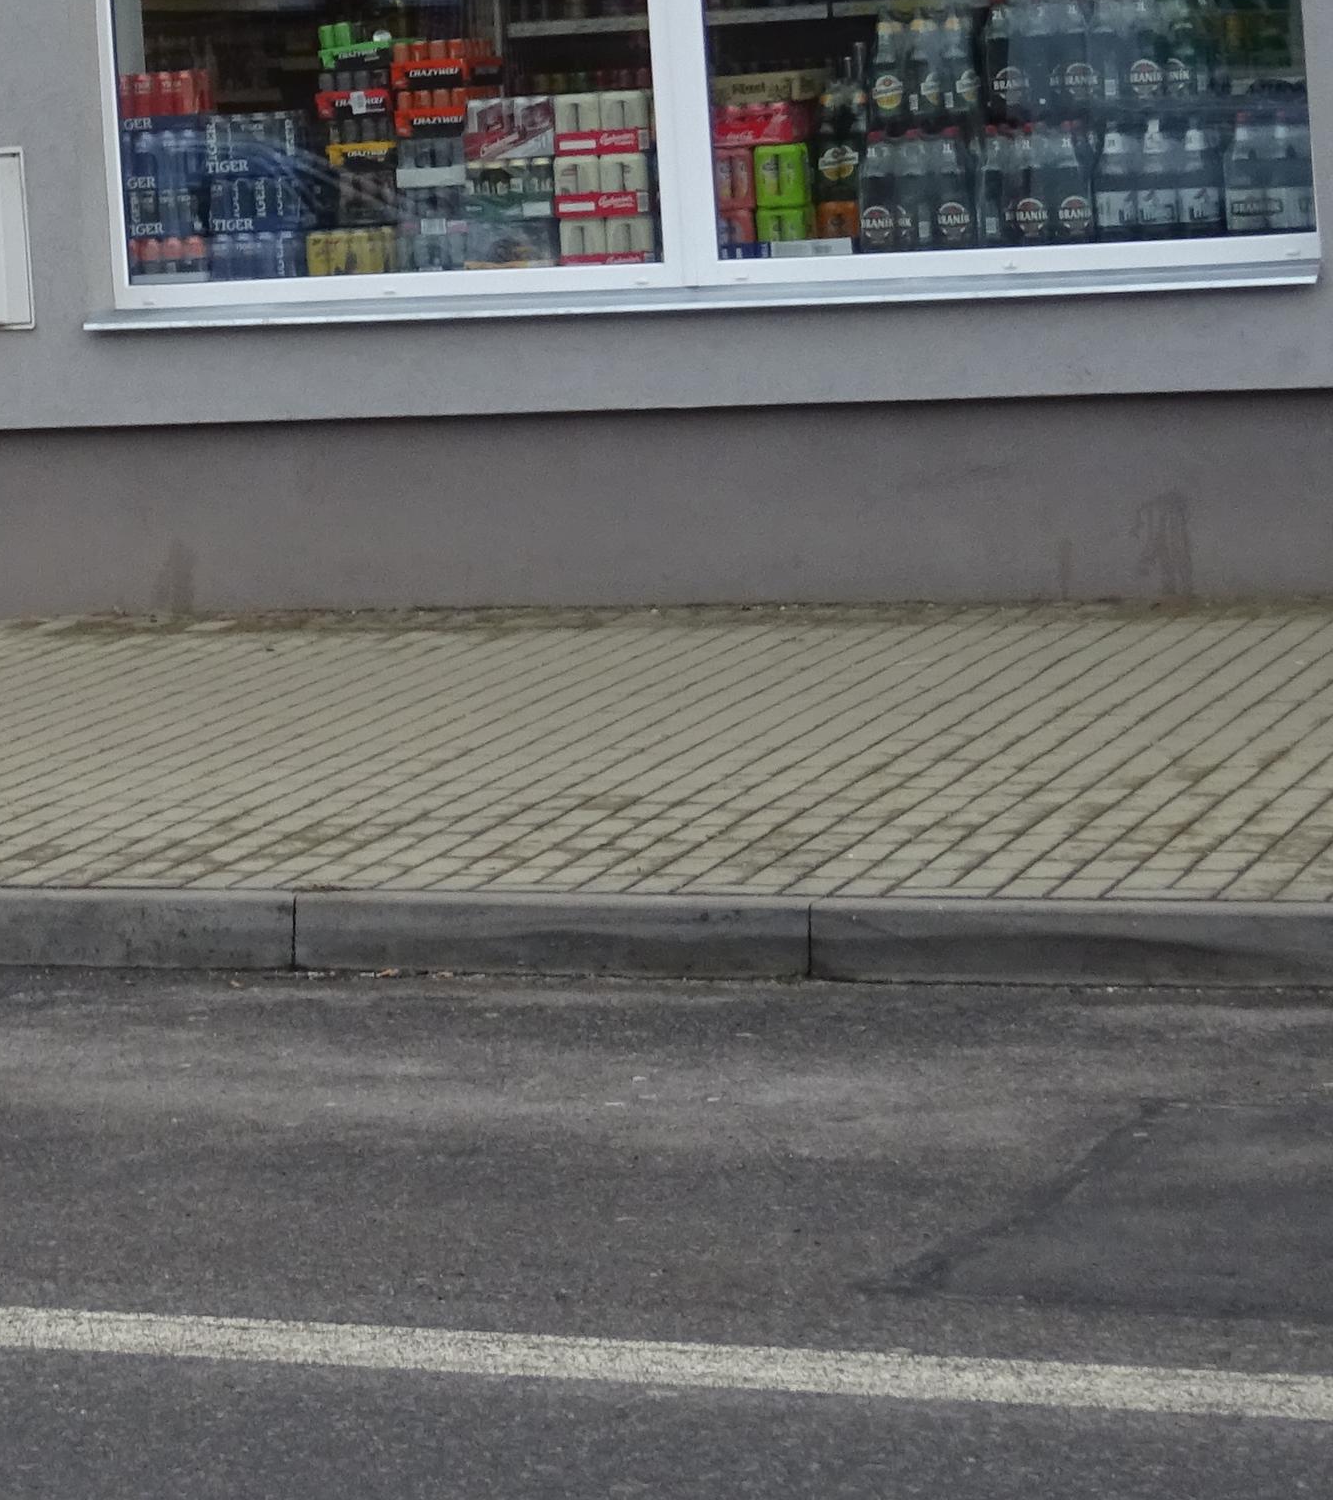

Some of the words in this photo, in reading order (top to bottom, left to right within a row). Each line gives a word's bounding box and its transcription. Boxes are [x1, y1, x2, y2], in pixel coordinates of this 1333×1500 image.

[123, 117, 153, 130] GER
[206, 159, 250, 174] TIGER
[127, 176, 156, 189] GER
[129, 221, 165, 236] IGER
[213, 217, 254, 231] TIGER
